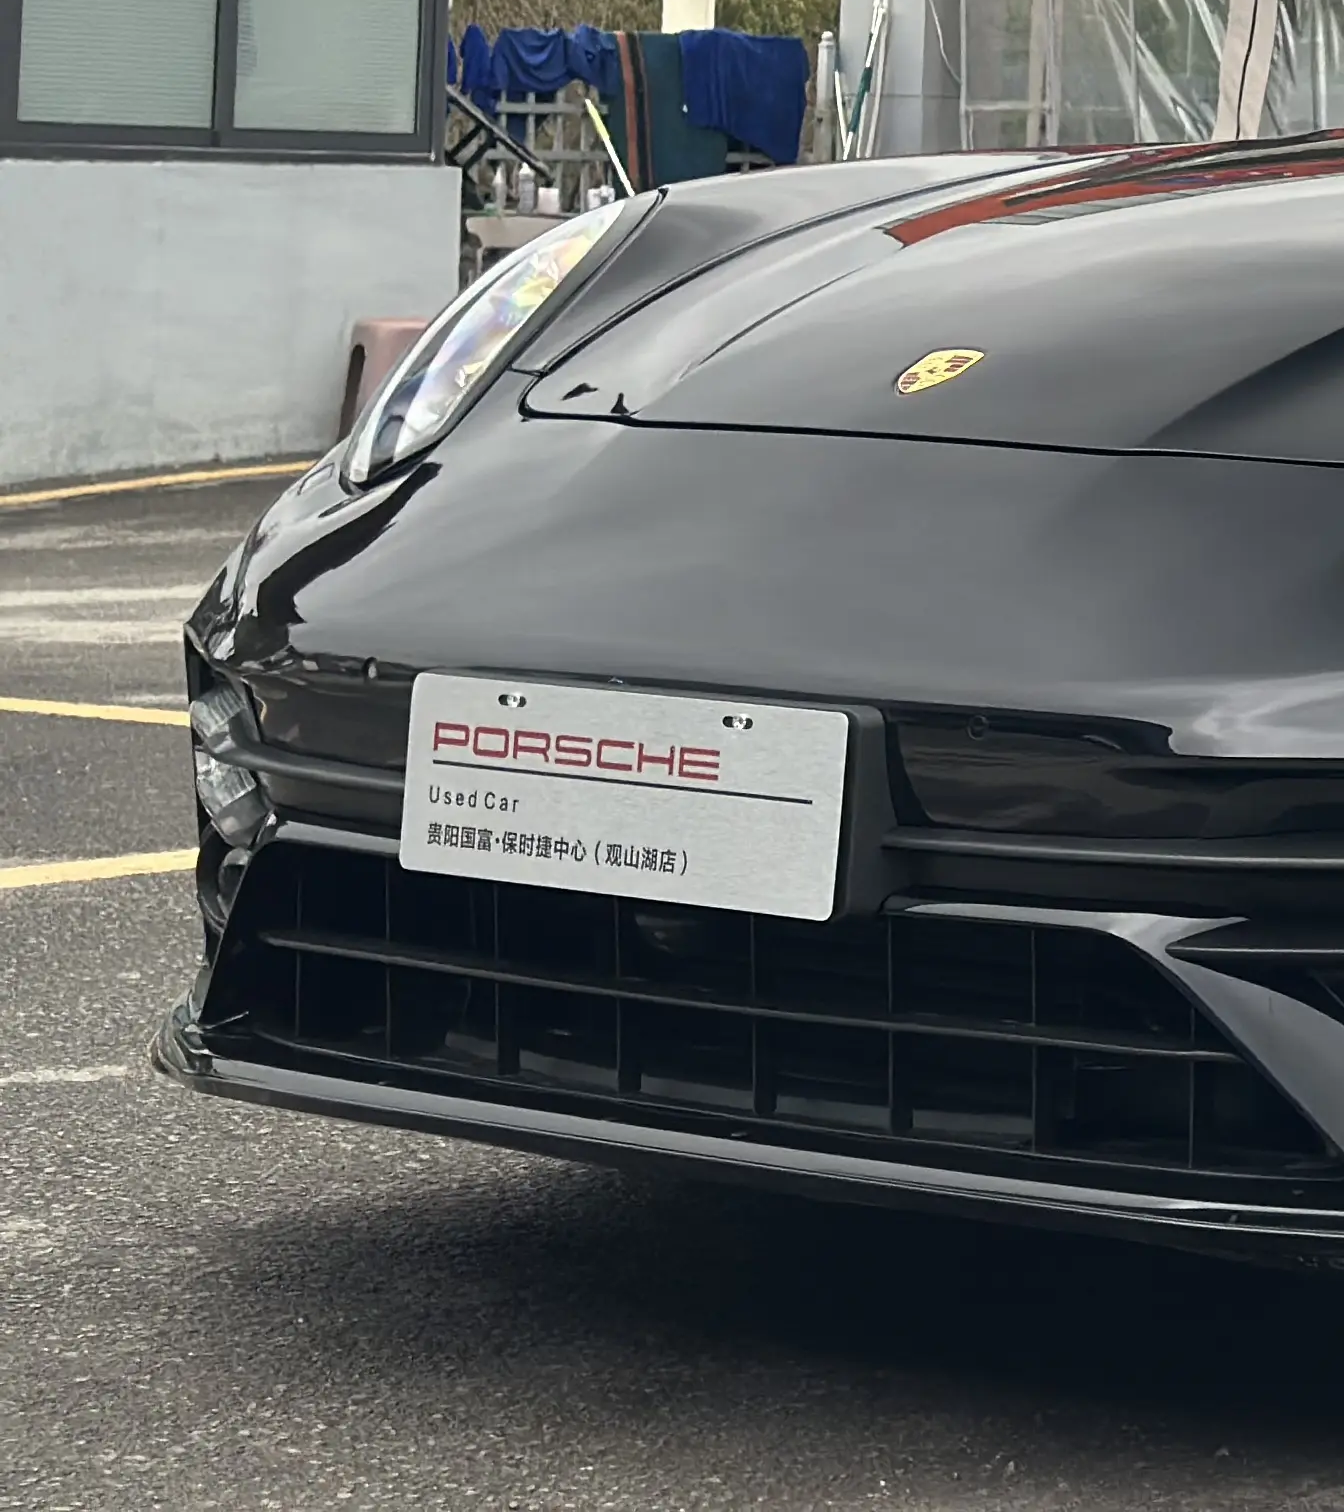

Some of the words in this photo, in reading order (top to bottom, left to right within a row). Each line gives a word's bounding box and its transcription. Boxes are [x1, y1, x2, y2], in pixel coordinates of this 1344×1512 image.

[432, 721, 721, 781] PORSCHE
[428, 785, 478, 809] Used
[484, 791, 520, 814] Car
